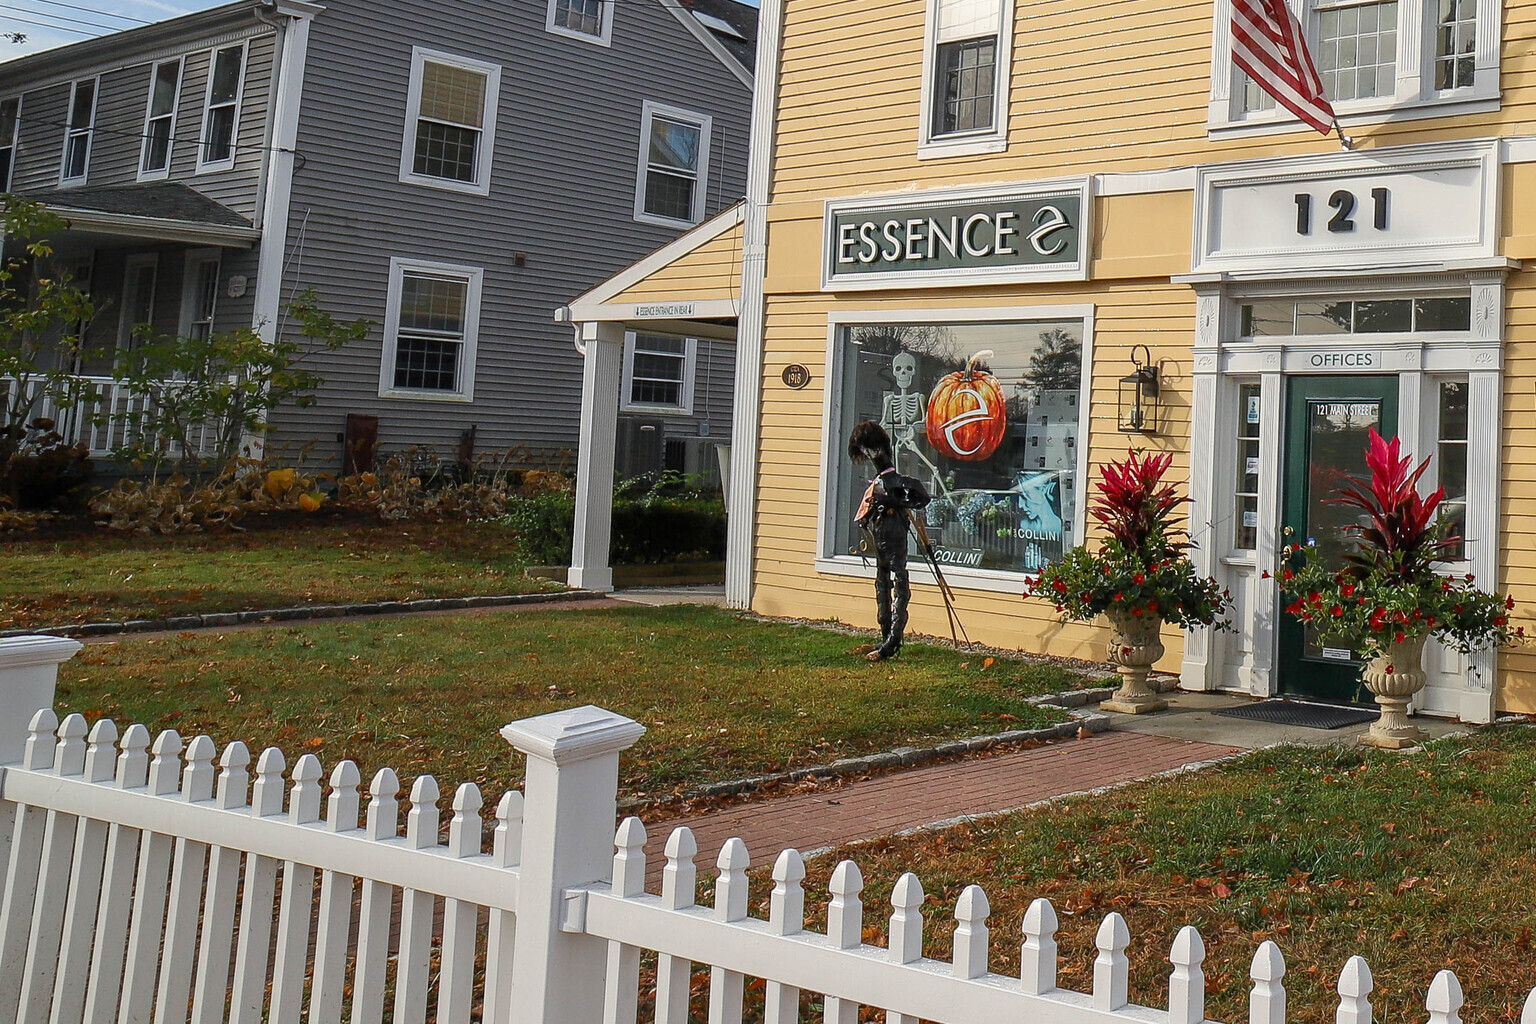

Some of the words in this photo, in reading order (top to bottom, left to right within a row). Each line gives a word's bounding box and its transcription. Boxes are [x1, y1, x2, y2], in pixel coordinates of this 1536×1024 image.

[1294, 187, 1389, 235] 121
[838, 211, 1016, 264] ESSENCE
[1310, 353, 1373, 367] OFFICES
[1316, 404, 1329, 416] 121
[1330, 404, 1349, 416] MAIN
[1349, 404, 1373, 416] STREET
